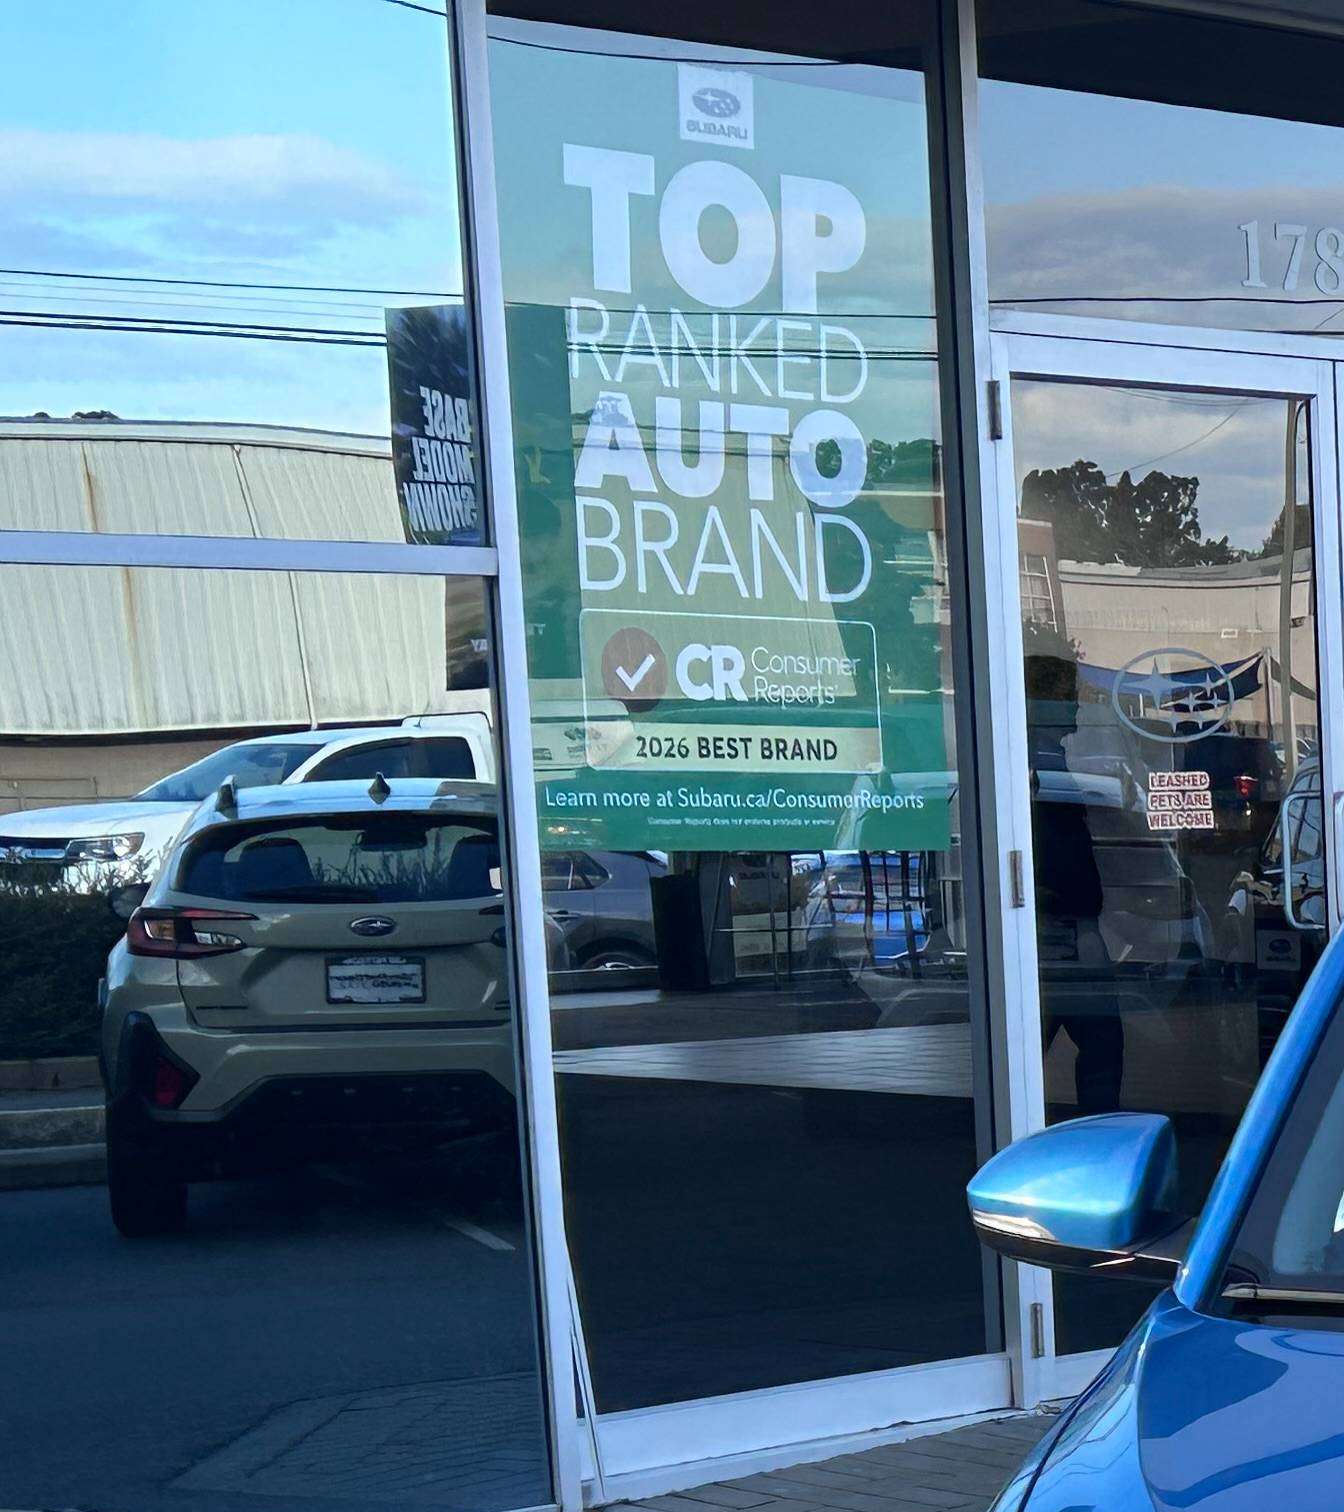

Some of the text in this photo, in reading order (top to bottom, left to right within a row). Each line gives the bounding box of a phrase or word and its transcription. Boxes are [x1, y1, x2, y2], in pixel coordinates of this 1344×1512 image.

[686, 119, 748, 140] SUBARU
[563, 143, 866, 313] TOP
[569, 297, 869, 403] RANKED
[574, 391, 868, 508] AUTO
[575, 495, 872, 603] BRAND
[676, 643, 748, 702] CR
[751, 646, 861, 676] Consumer
[636, 735, 838, 761] 2026 BEST BRAND
[1151, 773, 1208, 788] LEASHED
[545, 785, 925, 814] Learn more at Subaru.ca/ConsumerReports
[1151, 793, 1210, 808] PETS ARE
[1149, 813, 1212, 828] WELCOME
